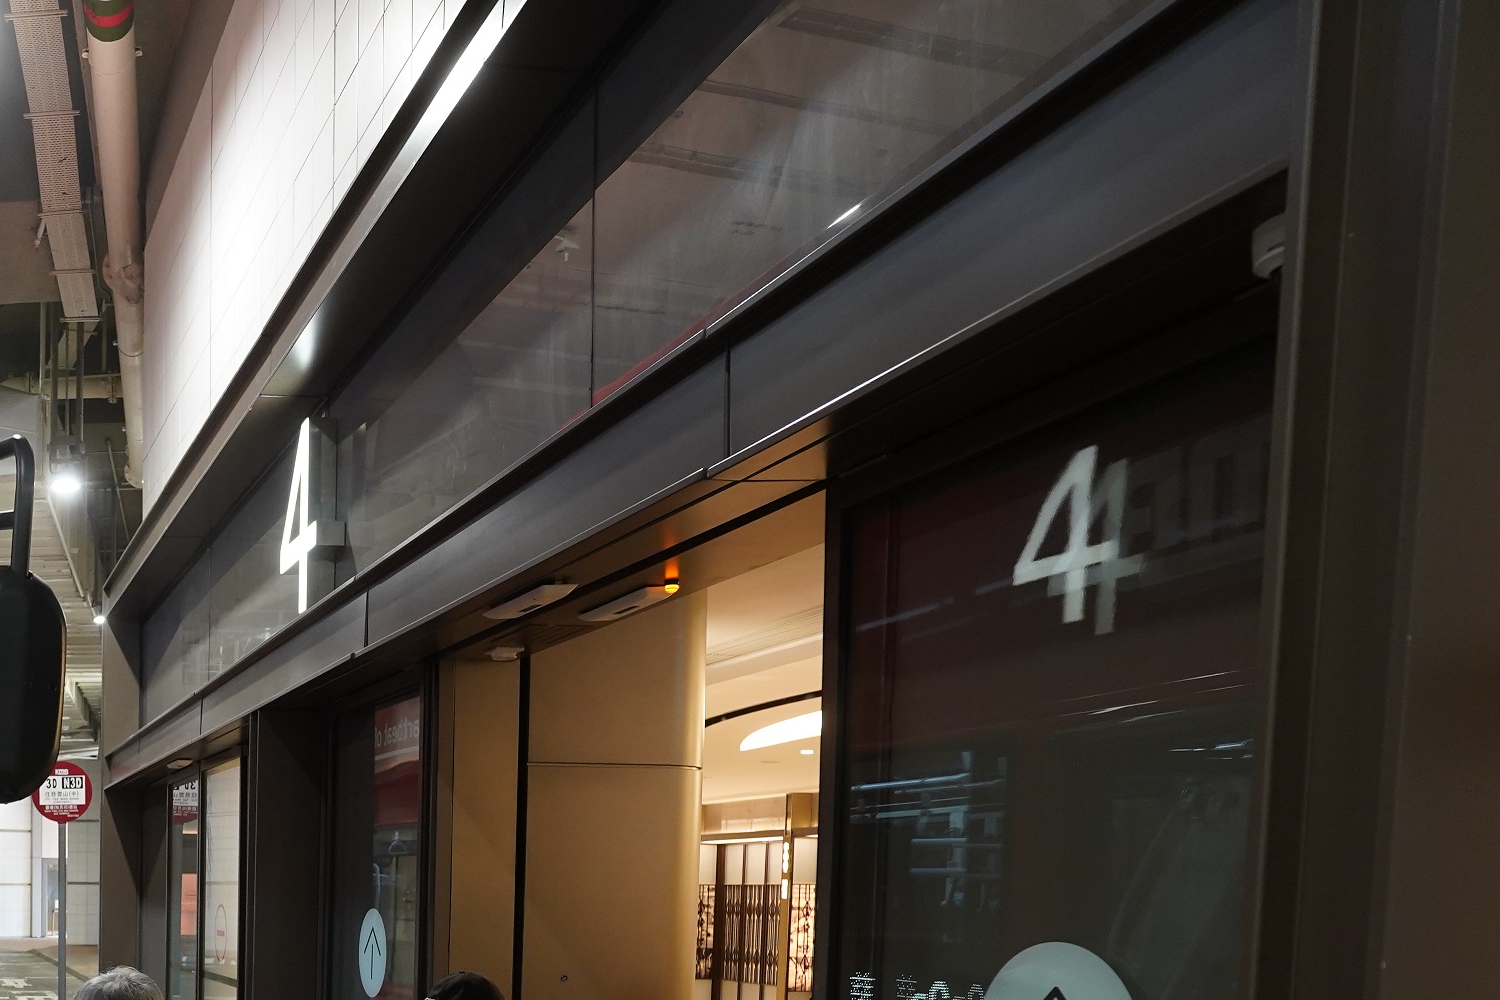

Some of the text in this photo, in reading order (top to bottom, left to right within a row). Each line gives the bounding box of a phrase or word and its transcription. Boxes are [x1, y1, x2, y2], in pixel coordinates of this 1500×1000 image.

[279, 416, 318, 615] 4
[1012, 444, 1120, 625] 4
[45, 777, 82, 789] 3D N3D
